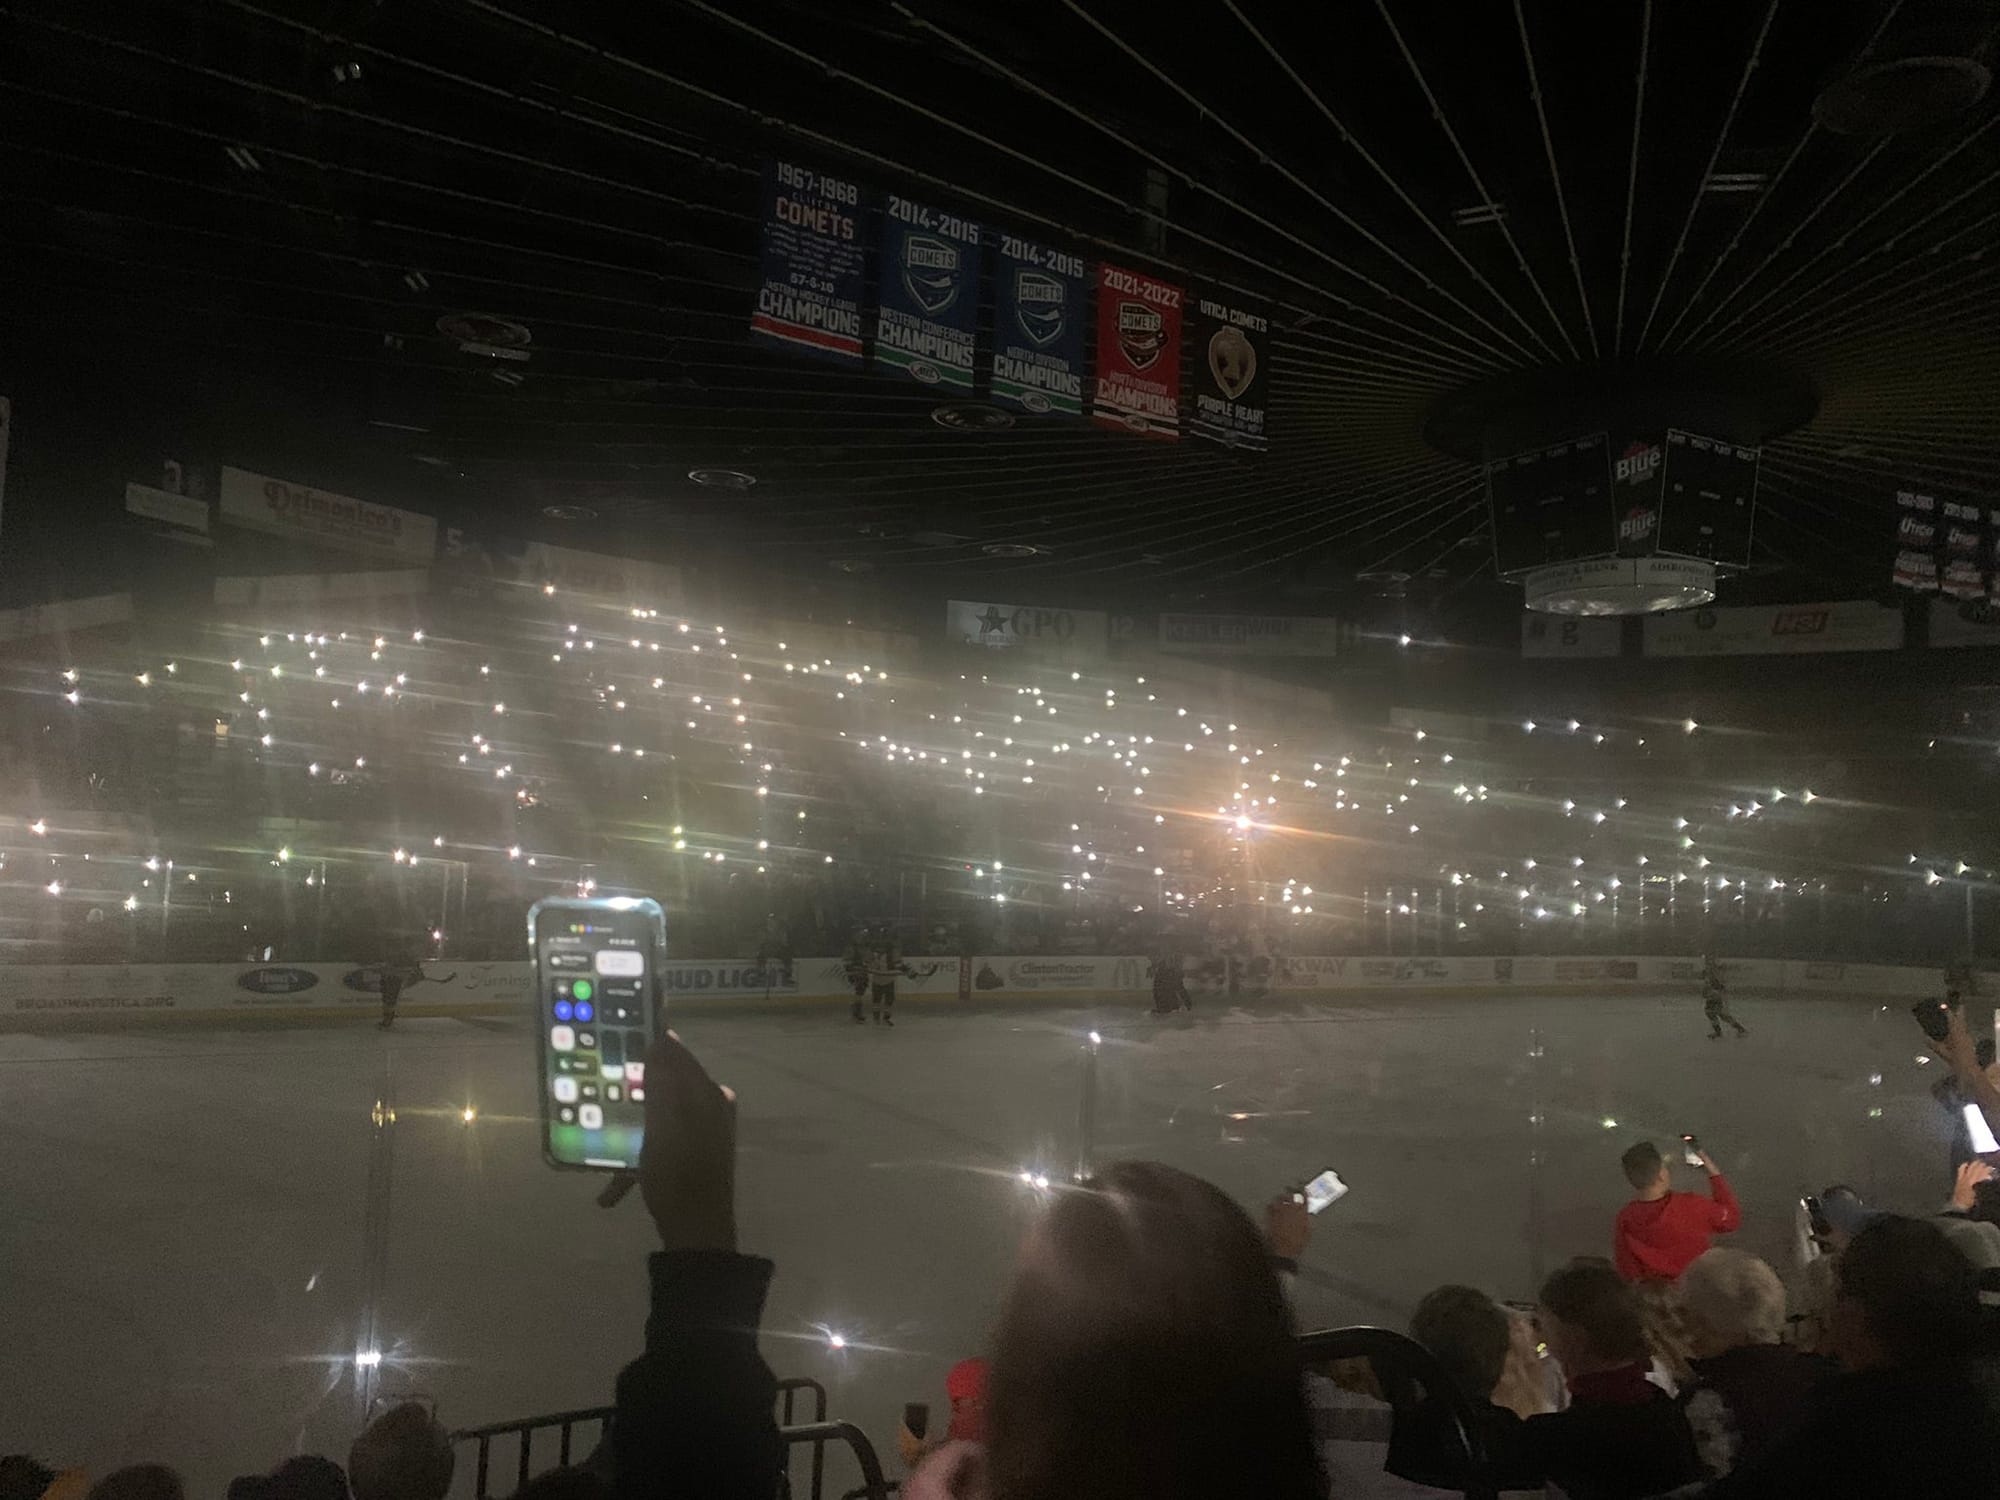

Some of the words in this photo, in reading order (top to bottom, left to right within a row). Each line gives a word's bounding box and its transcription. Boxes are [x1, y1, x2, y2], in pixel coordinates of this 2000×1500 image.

[777, 161, 857, 206] 1967-1968
[776, 196, 854, 240] COMETS
[888, 195, 978, 245] 2014-2015
[910, 249, 955, 267] COMETS
[1001, 235, 1084, 279] 2014-2015
[1104, 267, 1179, 309] 2021-2022
[759, 288, 861, 336] CHAMPIONS
[880, 304, 921, 330] WESTERN
[921, 319, 976, 346] CONFERENCE
[1121, 313, 1159, 330] COMETS
[1200, 299, 1228, 321] UTICA
[1230, 309, 1268, 334] COMETS
[878, 319, 974, 367] CHAMPIONS
[993, 354, 1081, 396] CHAMPIONS
[1098, 378, 1178, 417] CHAMPIONS
[1616, 445, 1661, 480] Blue
[1620, 512, 1656, 539] Blue
[1011, 607, 1075, 640] GPO
